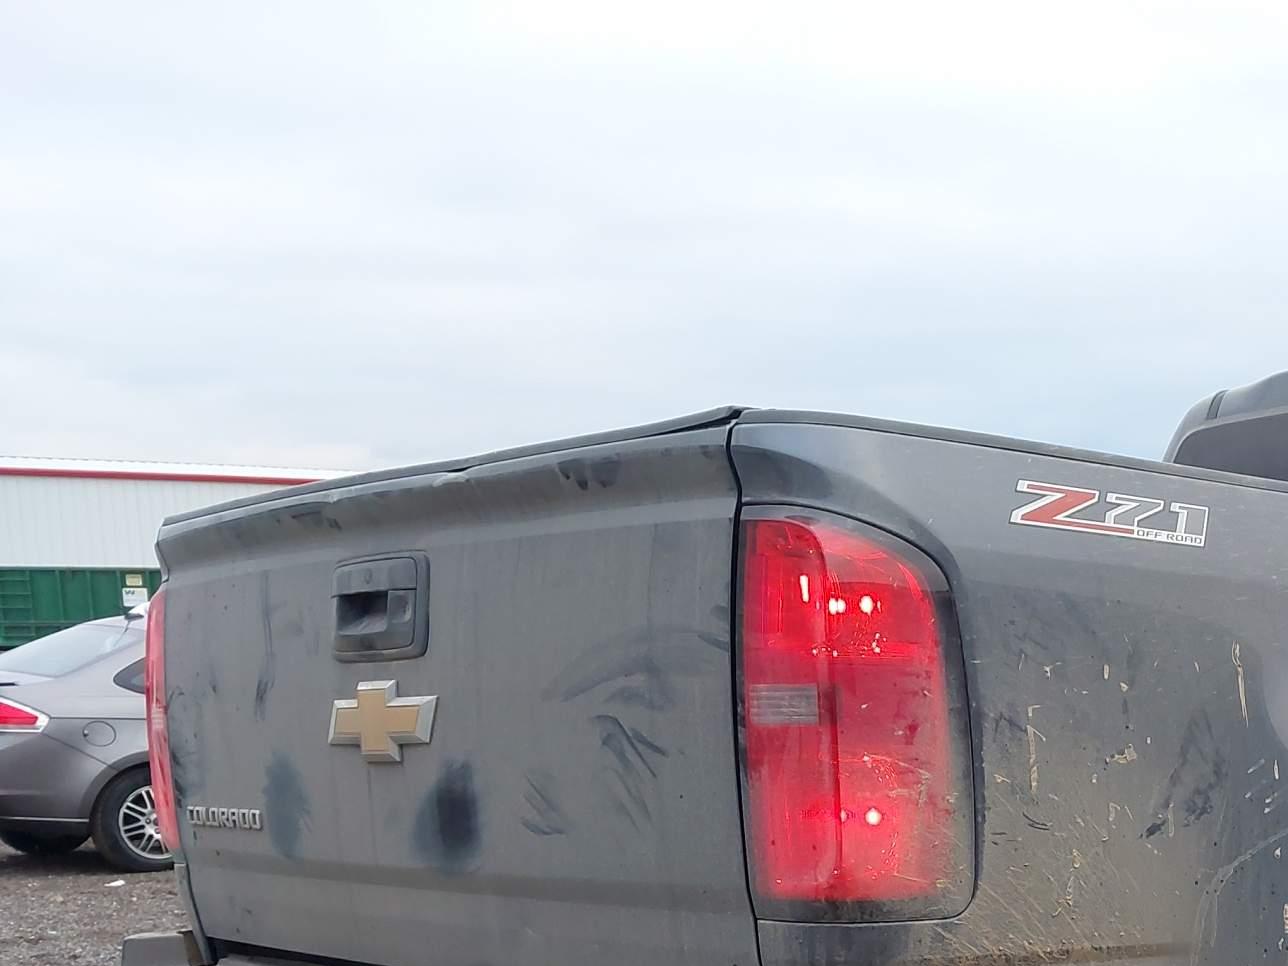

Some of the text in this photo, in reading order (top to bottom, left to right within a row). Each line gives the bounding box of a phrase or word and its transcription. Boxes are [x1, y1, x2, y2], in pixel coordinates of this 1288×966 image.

[1009, 480, 1209, 547] Z71
[1136, 529, 1203, 545] OFF ROAD
[186, 805, 262, 831] COLORADO
